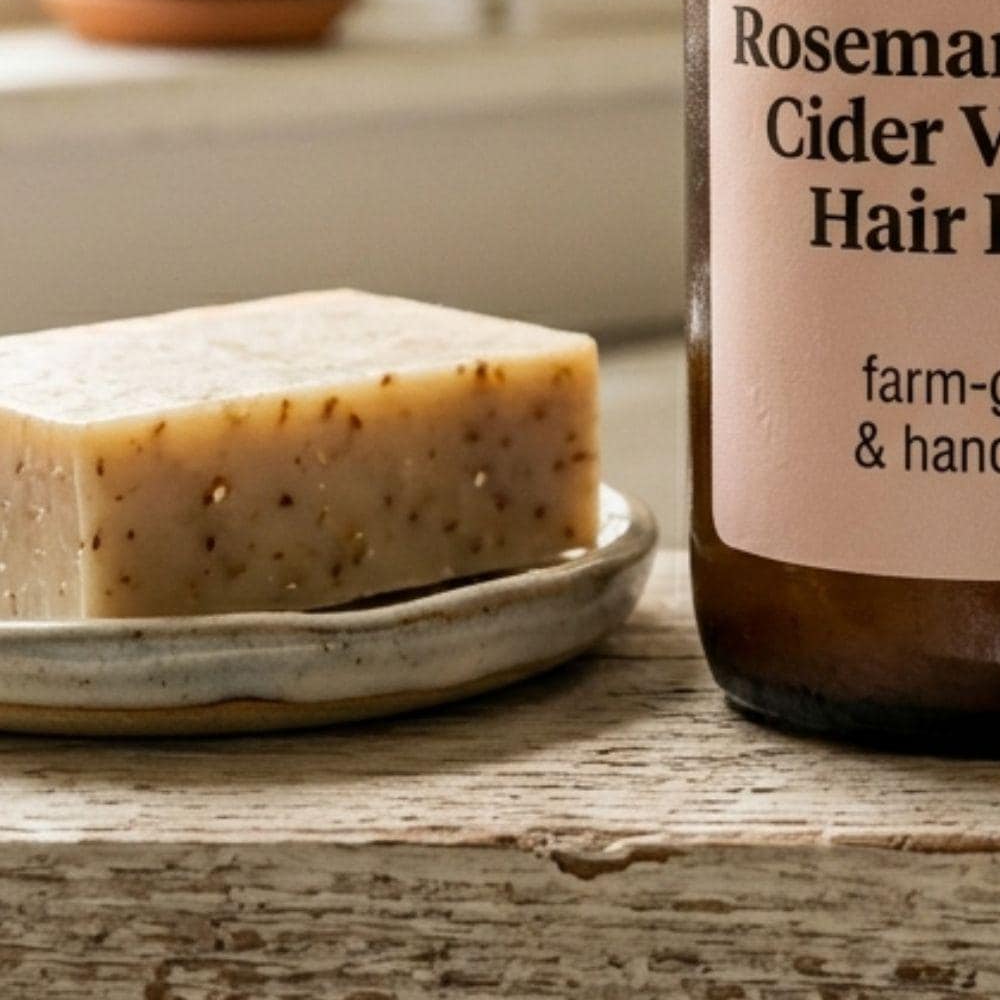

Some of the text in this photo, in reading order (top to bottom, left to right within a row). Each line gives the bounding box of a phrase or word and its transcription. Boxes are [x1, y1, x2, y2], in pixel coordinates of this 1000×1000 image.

[766, 94, 945, 167] Cider
[809, 186, 967, 256] Hair
[854, 420, 887, 470] &
